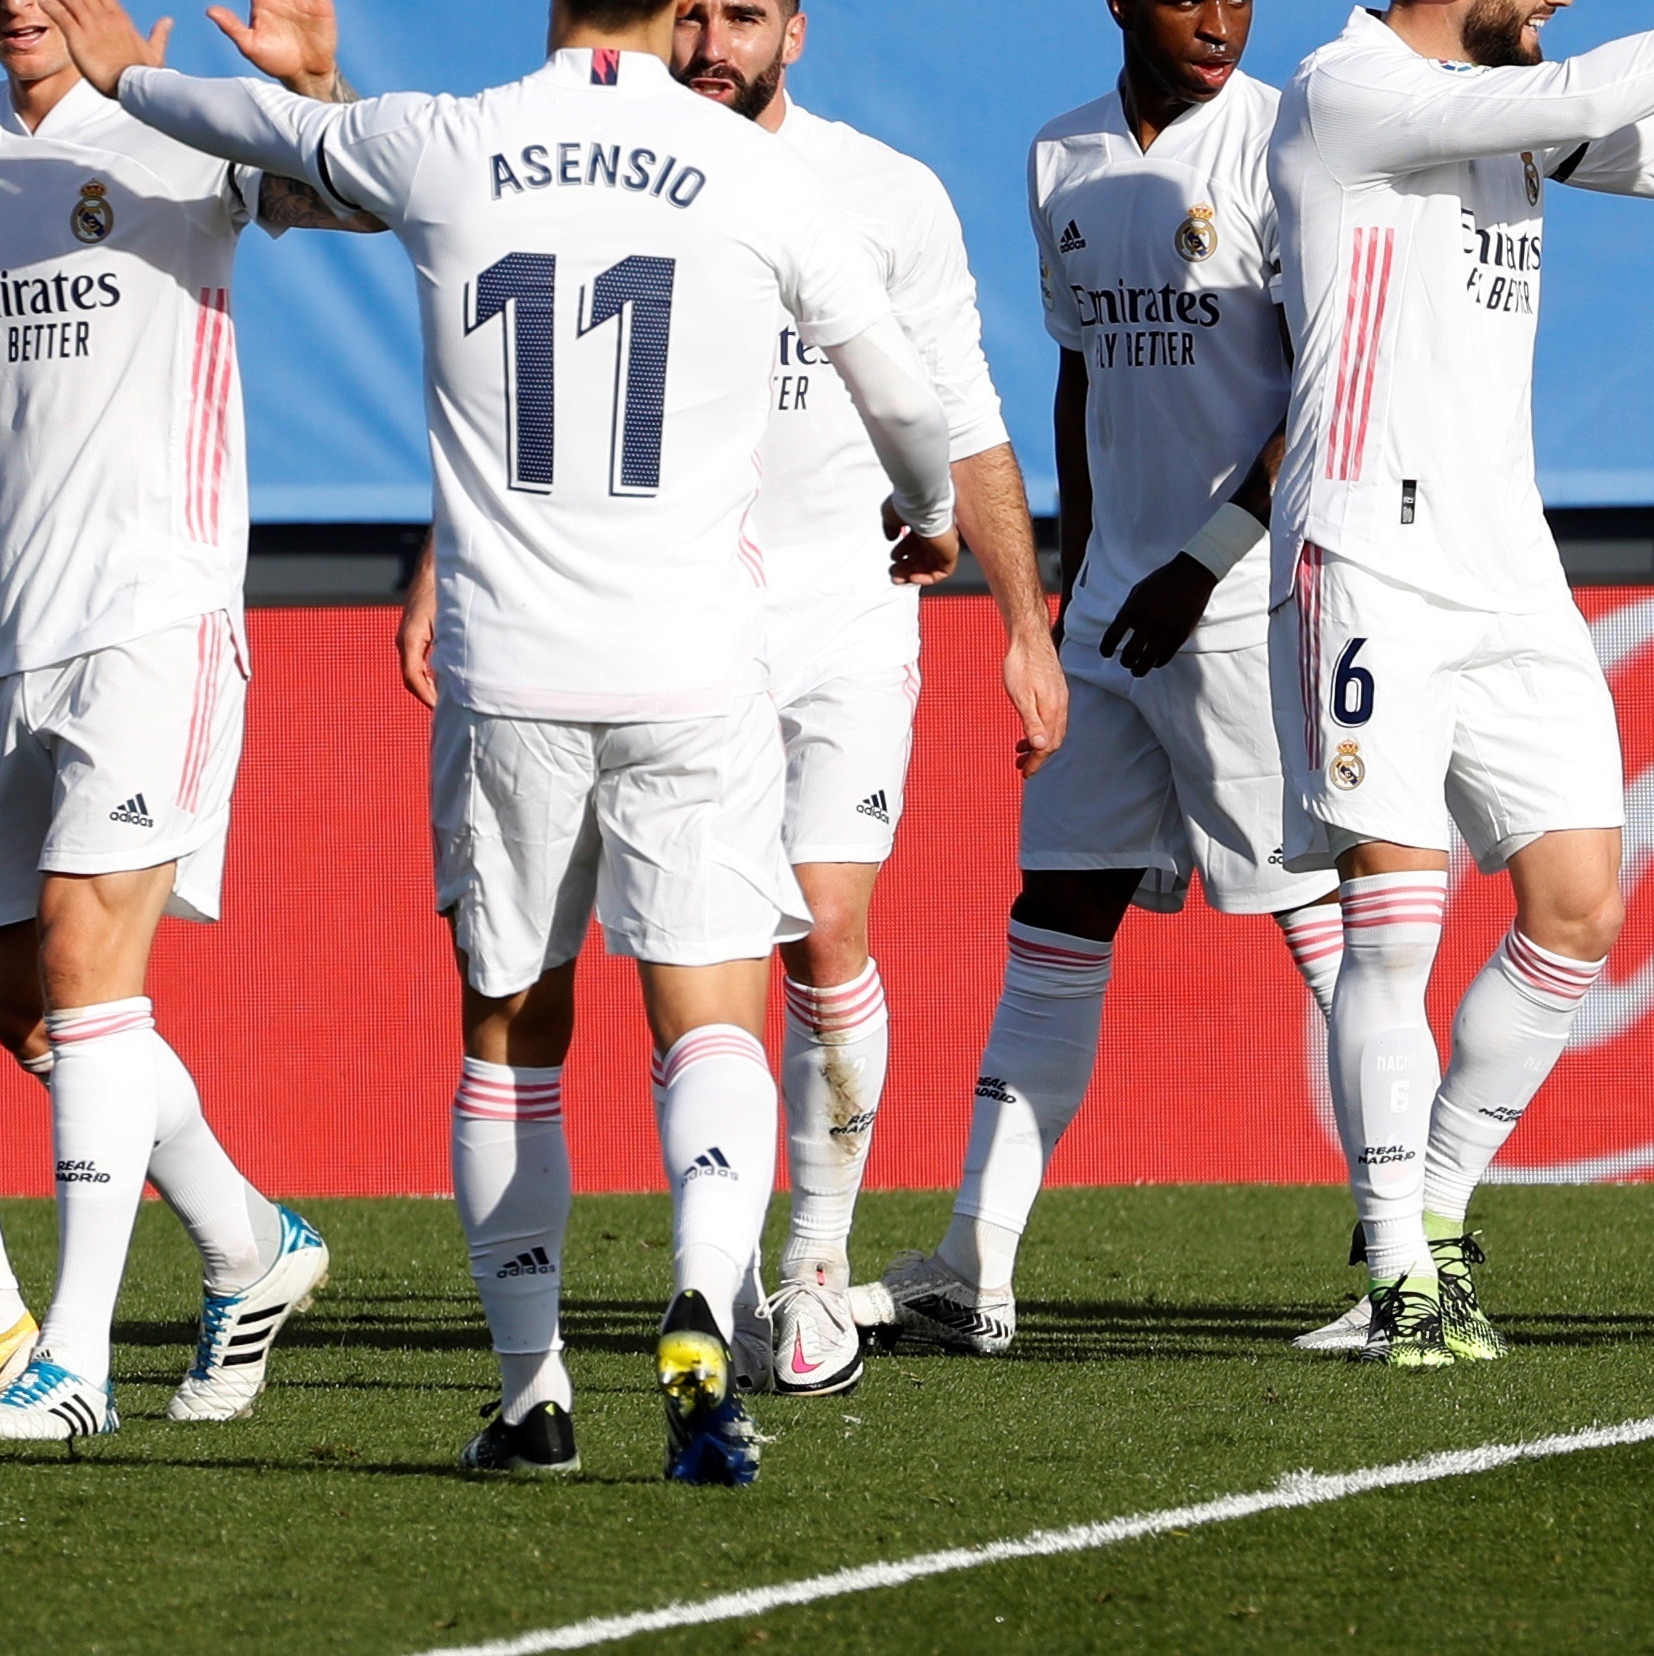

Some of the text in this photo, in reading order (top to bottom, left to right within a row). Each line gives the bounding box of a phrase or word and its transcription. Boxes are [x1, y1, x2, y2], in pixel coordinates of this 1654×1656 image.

[489, 142, 706, 209] ASENSIO
[1070, 278, 1221, 328] Emirates
[8, 321, 90, 363] BETTER
[463, 252, 676, 497] 11
[1329, 637, 1375, 729] 6
[109, 810, 154, 828] adidas
[56, 1160, 97, 1171] REAL
[1365, 1145, 1406, 1156] REAL
[496, 1264, 556, 1279] adidas
